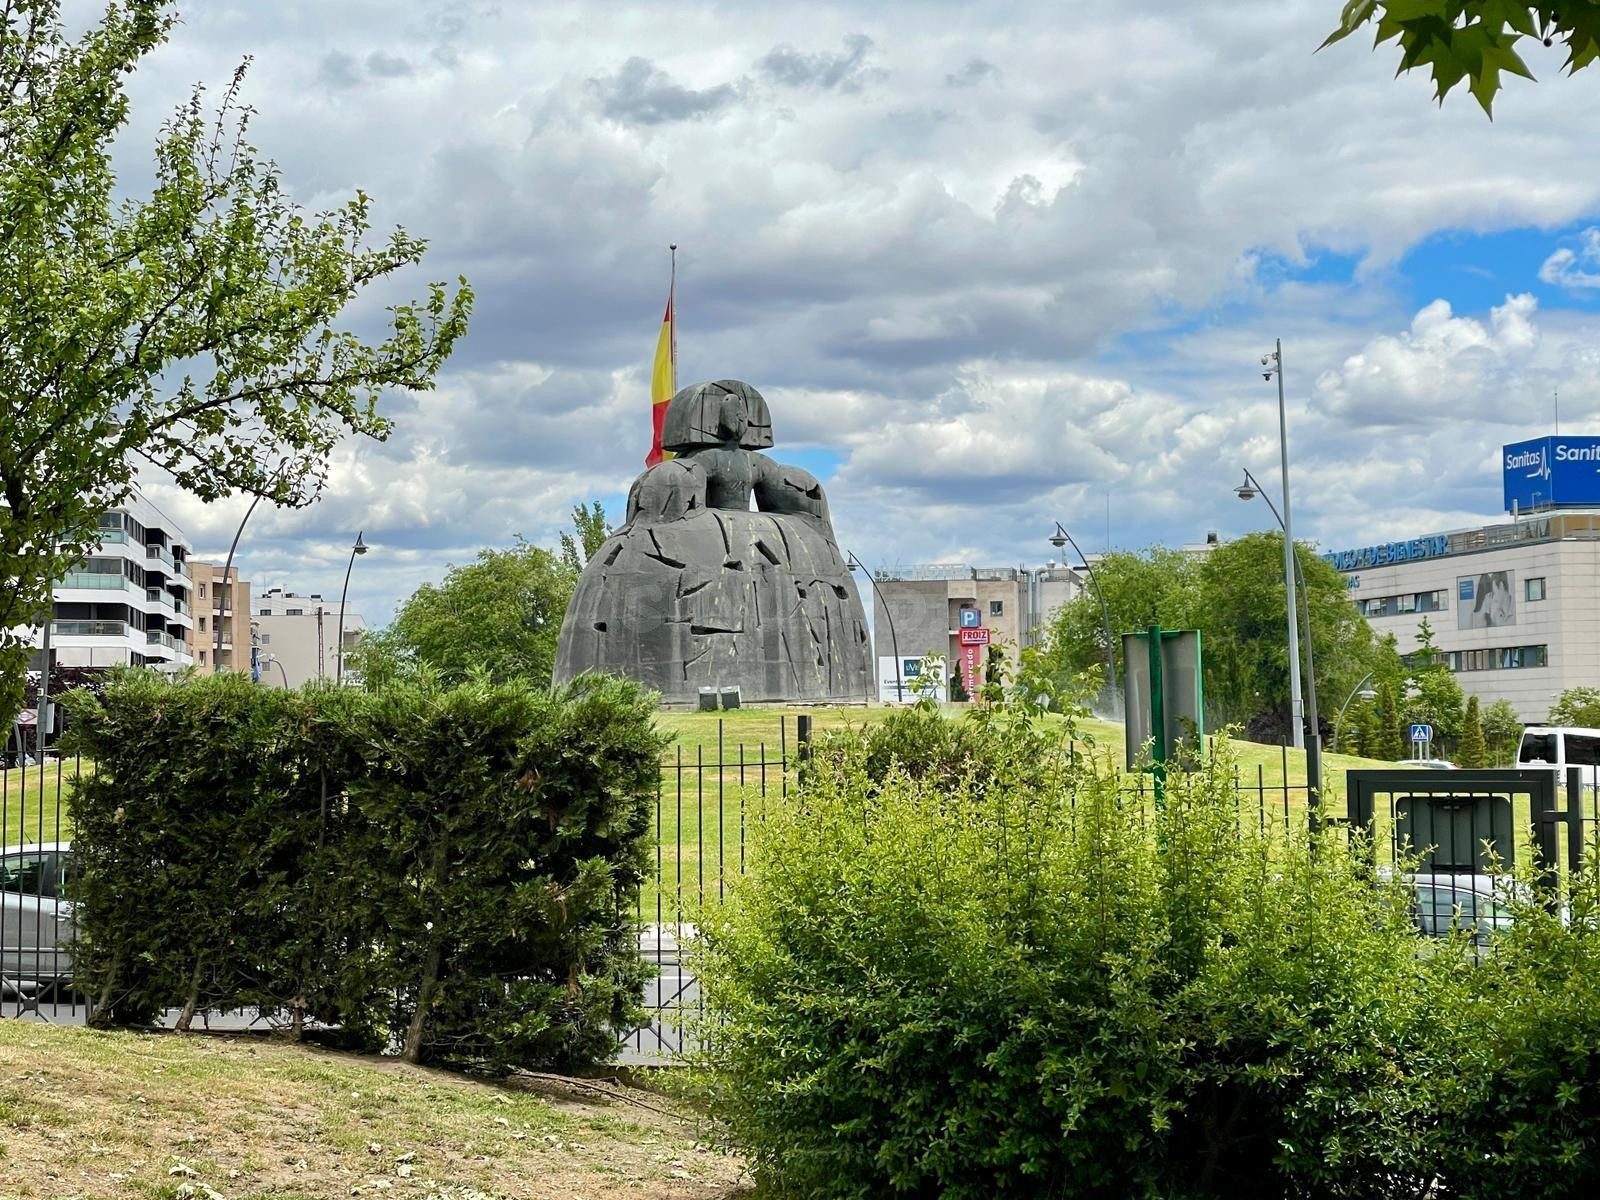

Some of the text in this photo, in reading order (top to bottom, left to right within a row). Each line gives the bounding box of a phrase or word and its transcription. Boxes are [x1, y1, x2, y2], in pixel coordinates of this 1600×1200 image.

[1506, 451, 1540, 470] Sanitas
[1369, 545, 1386, 564] DE
[1386, 535, 1448, 562] BIENESTAR
[964, 612, 974, 625] P
[963, 631, 987, 640] FROIZ
